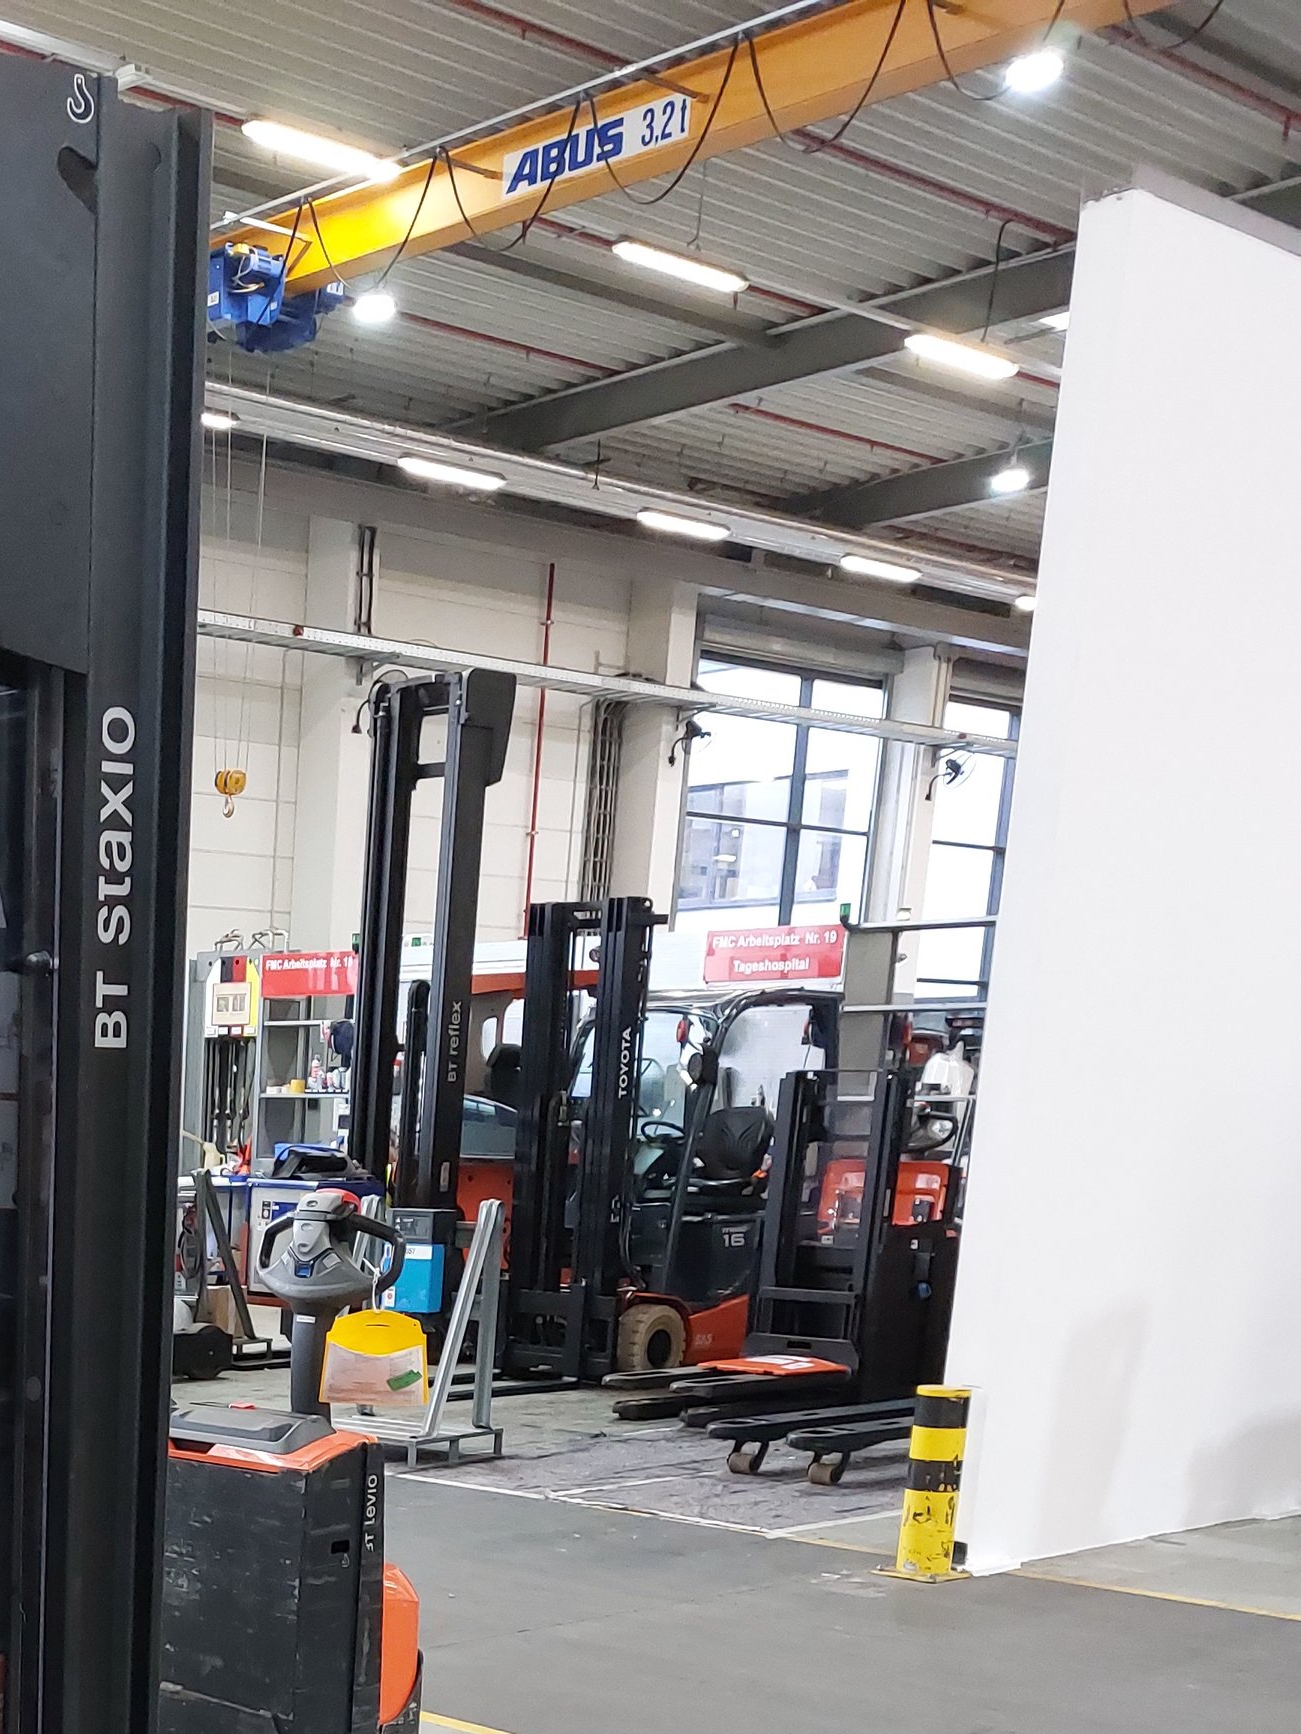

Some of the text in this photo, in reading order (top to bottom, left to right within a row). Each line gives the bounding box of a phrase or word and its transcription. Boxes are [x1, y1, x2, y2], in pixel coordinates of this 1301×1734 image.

[506, 117, 624, 194] ABUS
[283, 958, 327, 969] Arbeitsplatz
[738, 934, 800, 948] Arbeitsplatz
[805, 931, 821, 944] Nr.
[824, 930, 837, 944] 19
[733, 957, 810, 975] Tageshospital
[94, 970, 129, 1048] BT
[448, 1001, 462, 1082] BT reflex
[618, 1026, 633, 1099] TOYOTA
[723, 1234, 745, 1248] 16
[364, 1474, 378, 1526] Levio
